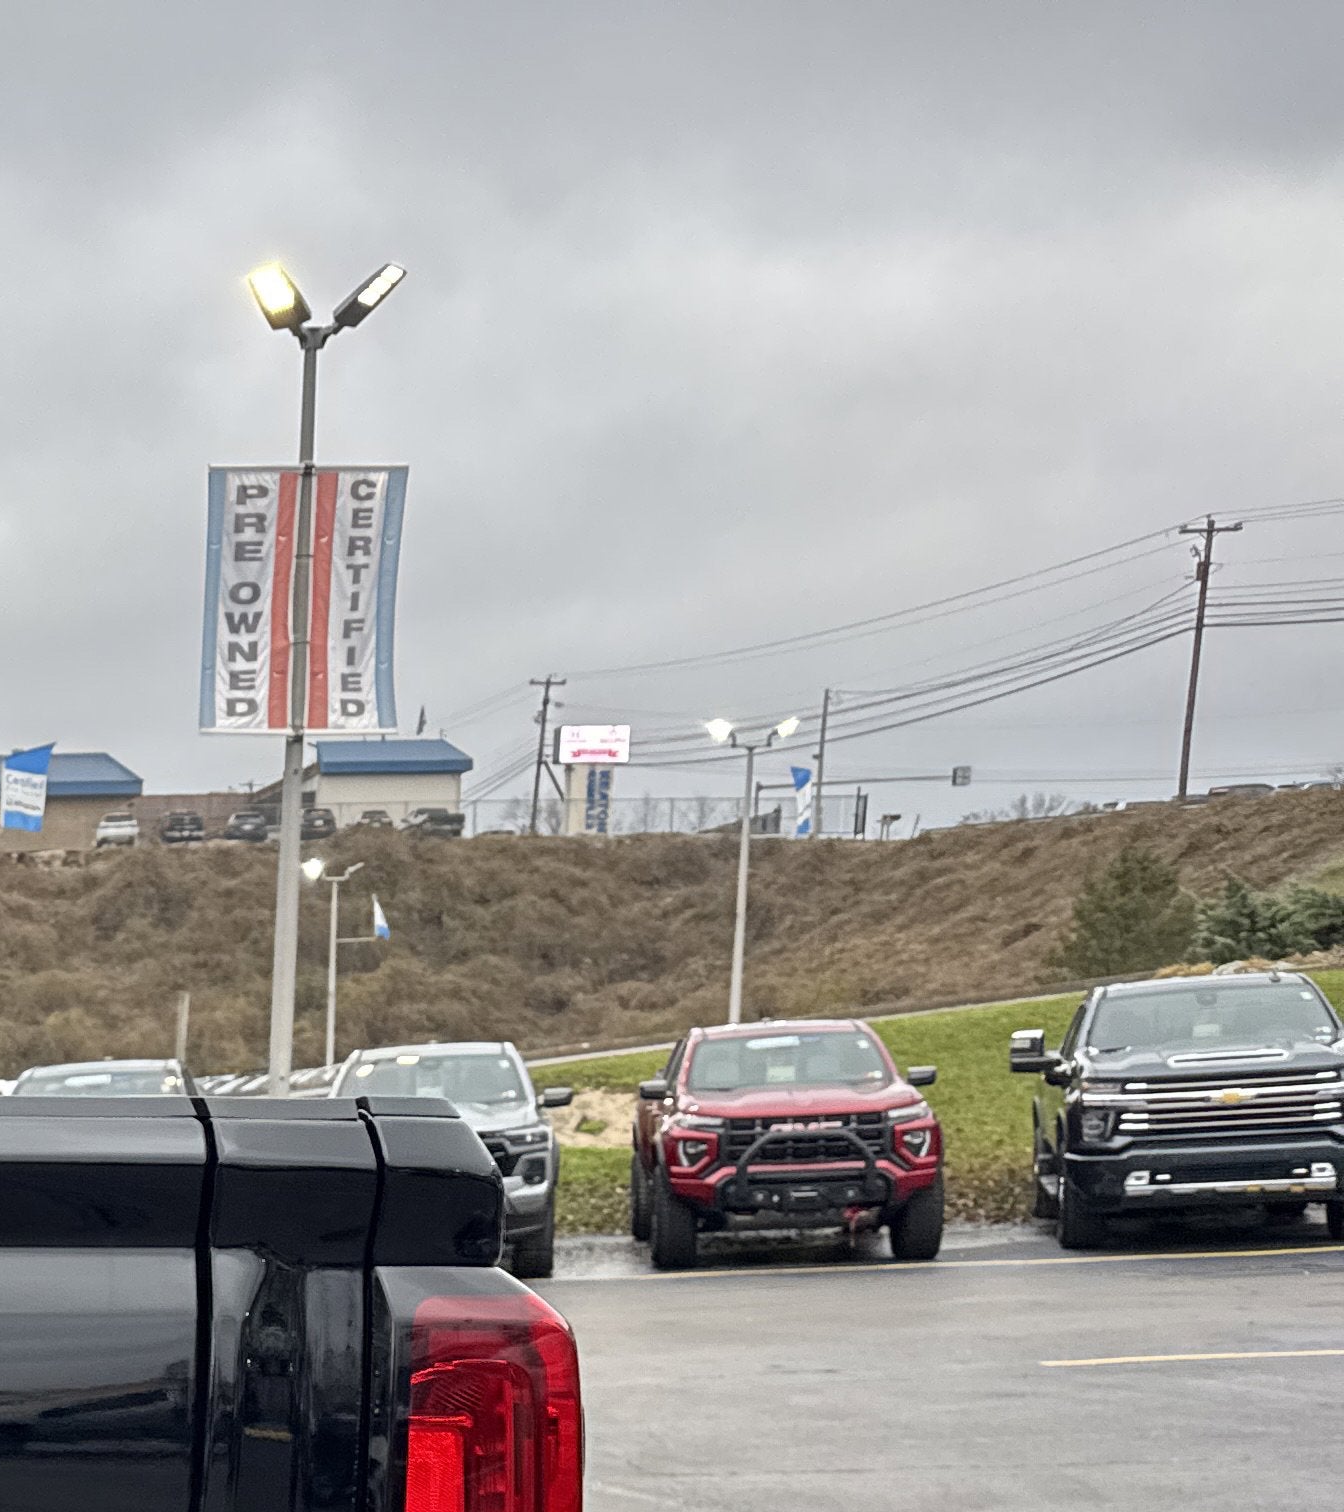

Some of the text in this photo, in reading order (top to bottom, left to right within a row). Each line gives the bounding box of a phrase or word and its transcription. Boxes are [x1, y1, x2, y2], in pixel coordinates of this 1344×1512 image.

[224, 484, 269, 717] PRE OWNED
[340, 479, 377, 718] CERTIFIED
